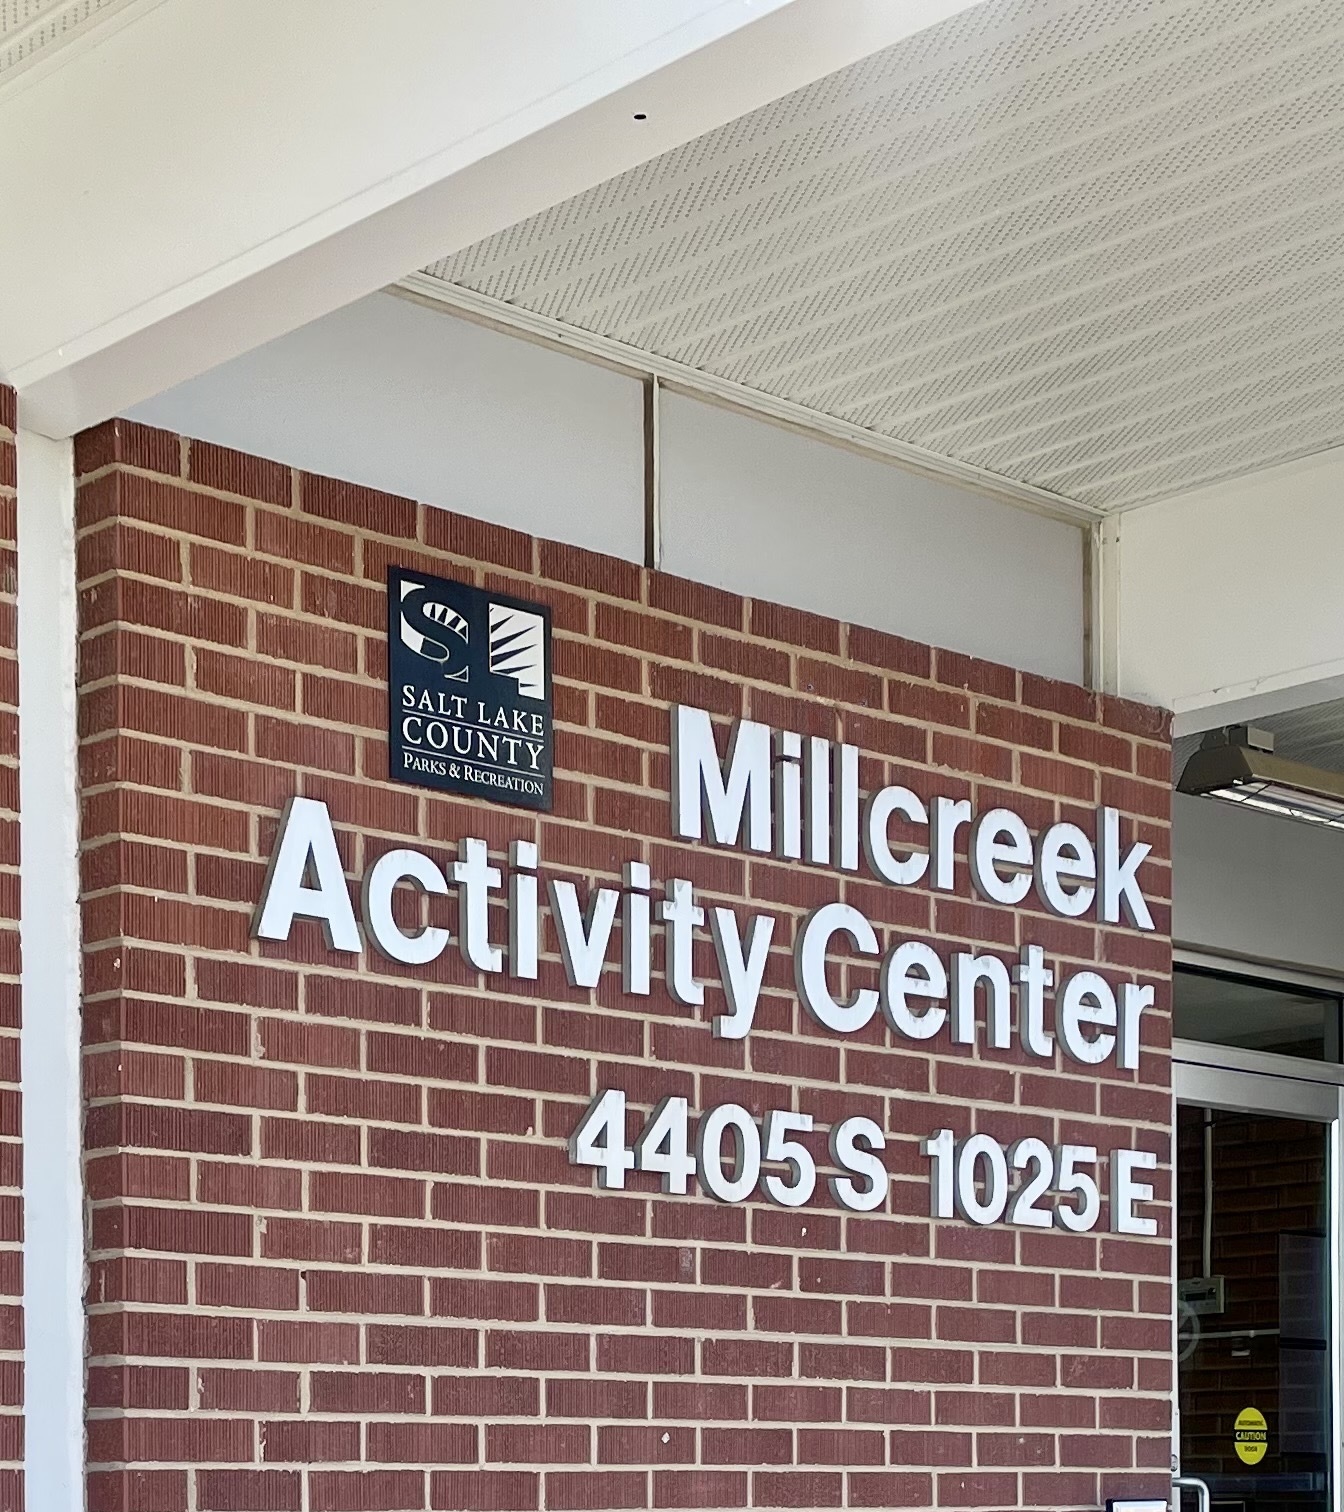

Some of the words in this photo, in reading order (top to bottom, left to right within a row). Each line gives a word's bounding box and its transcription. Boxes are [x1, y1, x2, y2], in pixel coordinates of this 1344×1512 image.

[402, 684, 468, 719] SALT
[477, 701, 544, 737] LAKE
[402, 716, 545, 771] COUNTY
[403, 751, 447, 776] PARKS
[448, 762, 461, 779] &
[464, 764, 544, 796] RECREATION
[670, 703, 1156, 931] Millcreek
[254, 795, 776, 1041] Activity
[794, 901, 1155, 1071] Center
[569, 1088, 816, 1208] 4405
[828, 1114, 889, 1213] S
[922, 1127, 1100, 1233] 1025
[1110, 1148, 1158, 1237] E
[1236, 1431, 1266, 1440] CAUTION
